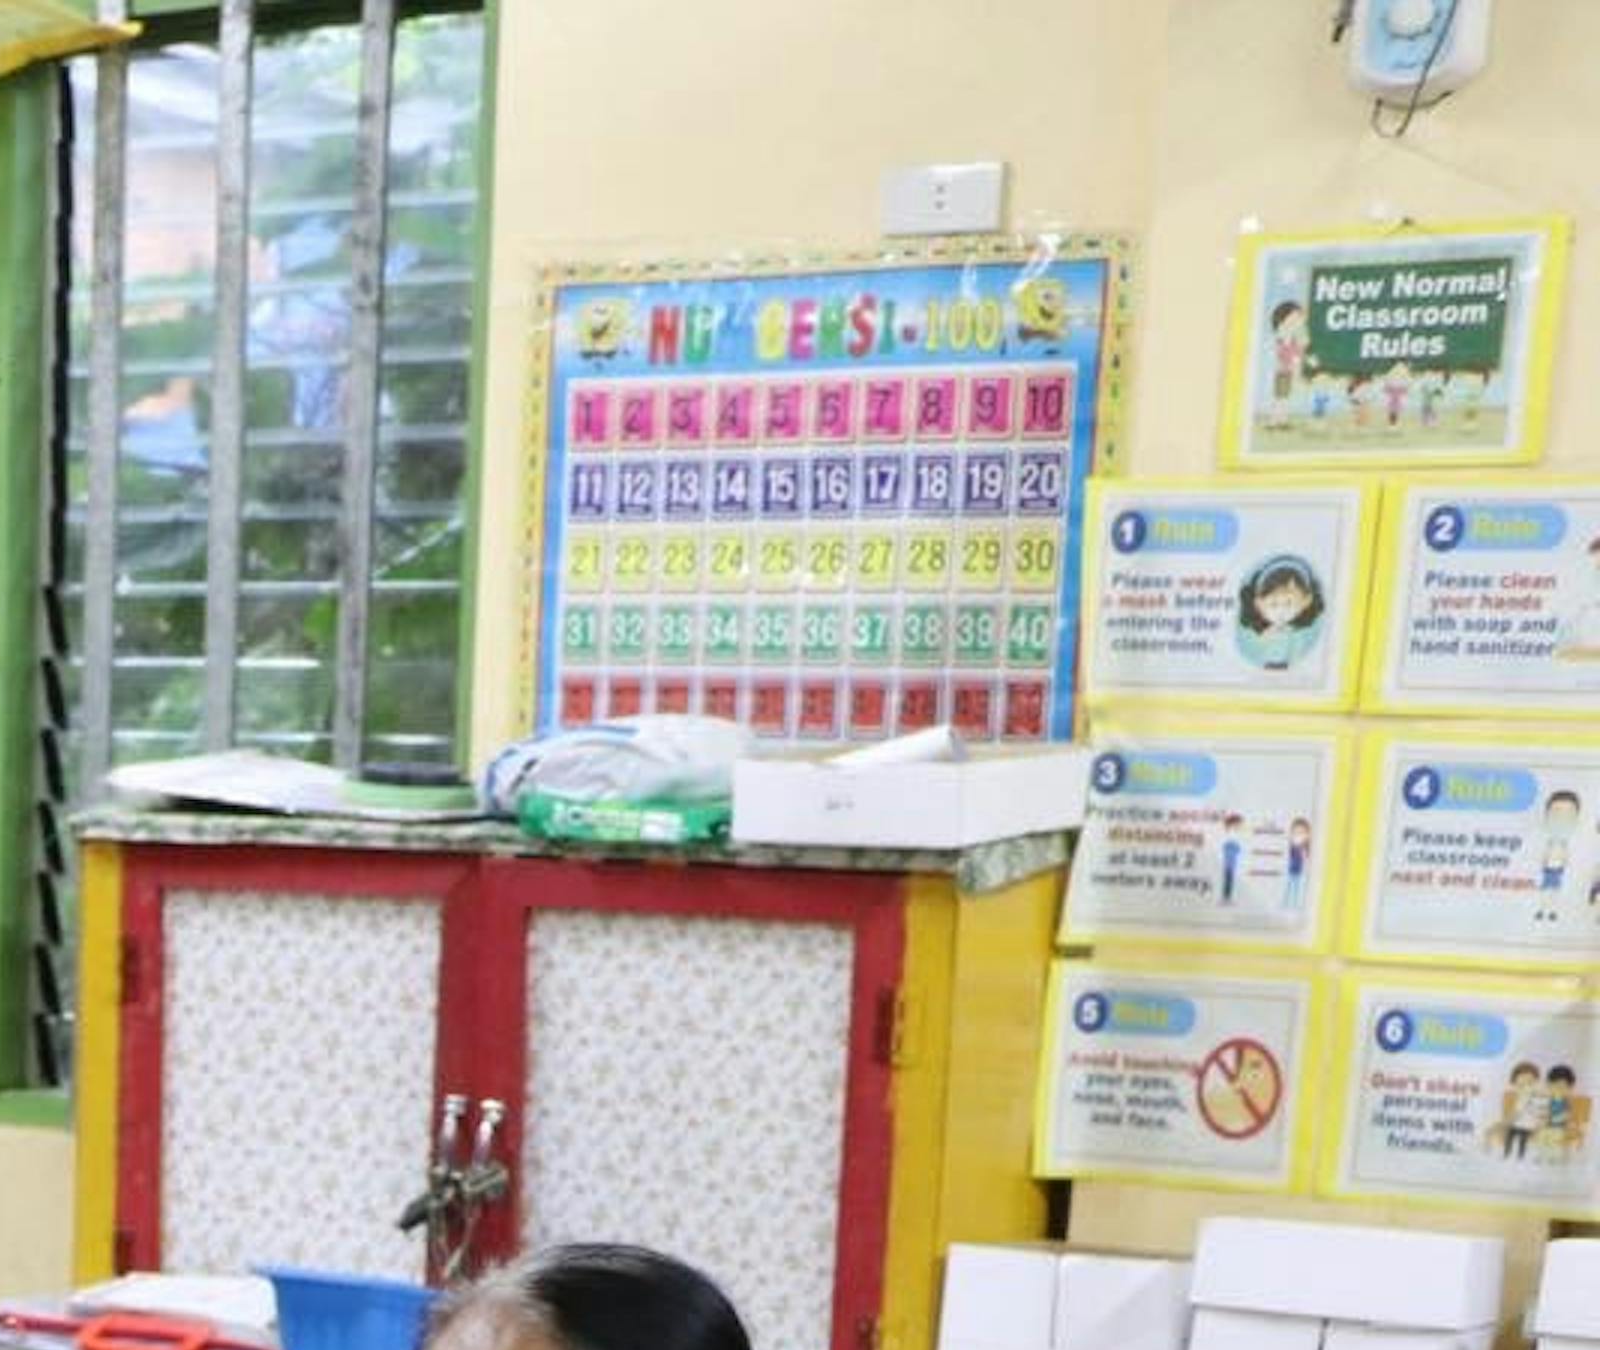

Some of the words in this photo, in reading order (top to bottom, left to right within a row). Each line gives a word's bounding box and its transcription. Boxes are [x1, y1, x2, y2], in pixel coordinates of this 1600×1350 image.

[1315, 275, 1382, 301] New
[1392, 270, 1507, 301] Normal
[1325, 303, 1488, 331] Classroom
[648, 294, 877, 366] NUBERS
[1360, 332, 1446, 358] Rules
[583, 400, 594, 432] 1
[625, 399, 644, 433] 2
[670, 398, 692, 431] 3
[720, 397, 739, 427] 4
[769, 394, 790, 428] 5
[873, 389, 893, 426] 7
[922, 387, 942, 425] 8
[976, 386, 997, 423] 9
[1027, 385, 1064, 422] 10
[578, 472, 602, 505] 11
[623, 471, 649, 504] 12
[670, 469, 698, 503] 13
[717, 468, 746, 502] 14
[768, 467, 796, 502] 15
[814, 466, 849, 501] 16
[867, 466, 897, 500] 17
[918, 466, 948, 500] 18
[969, 464, 1003, 499] 19
[1021, 463, 1060, 498] 20
[1119, 518, 1136, 545] 1
[1432, 515, 1455, 542] 2
[810, 541, 846, 575] 26
[859, 539, 893, 574] 27
[908, 539, 946, 573] 28
[963, 539, 1001, 573] 29
[1017, 538, 1054, 572] 30
[1111, 573, 1172, 590] Please
[1180, 575, 1226, 589] wear
[1425, 569, 1493, 589] Please
[1502, 569, 1557, 589] clean
[1174, 593, 1235, 610] before
[1431, 596, 1476, 614] your
[1479, 594, 1542, 611] hands
[855, 612, 887, 648] 37
[904, 611, 941, 647] 38
[1012, 613, 1050, 648] 40
[1190, 614, 1221, 629] the
[1412, 616, 1457, 631] with
[1463, 618, 1511, 634] soap
[1519, 616, 1558, 632] and
[1410, 637, 1460, 655] hand
[1099, 761, 1118, 786] 3
[1409, 775, 1432, 801] 4
[1403, 827, 1469, 847] Please
[1473, 831, 1523, 852] keep
[1407, 849, 1511, 868] classroom
[1440, 872, 1475, 887] and
[1082, 999, 1099, 1025] 5
[1385, 1016, 1404, 1043] 6
[1383, 1094, 1468, 1113] personal
[1431, 1117, 1474, 1133] with
